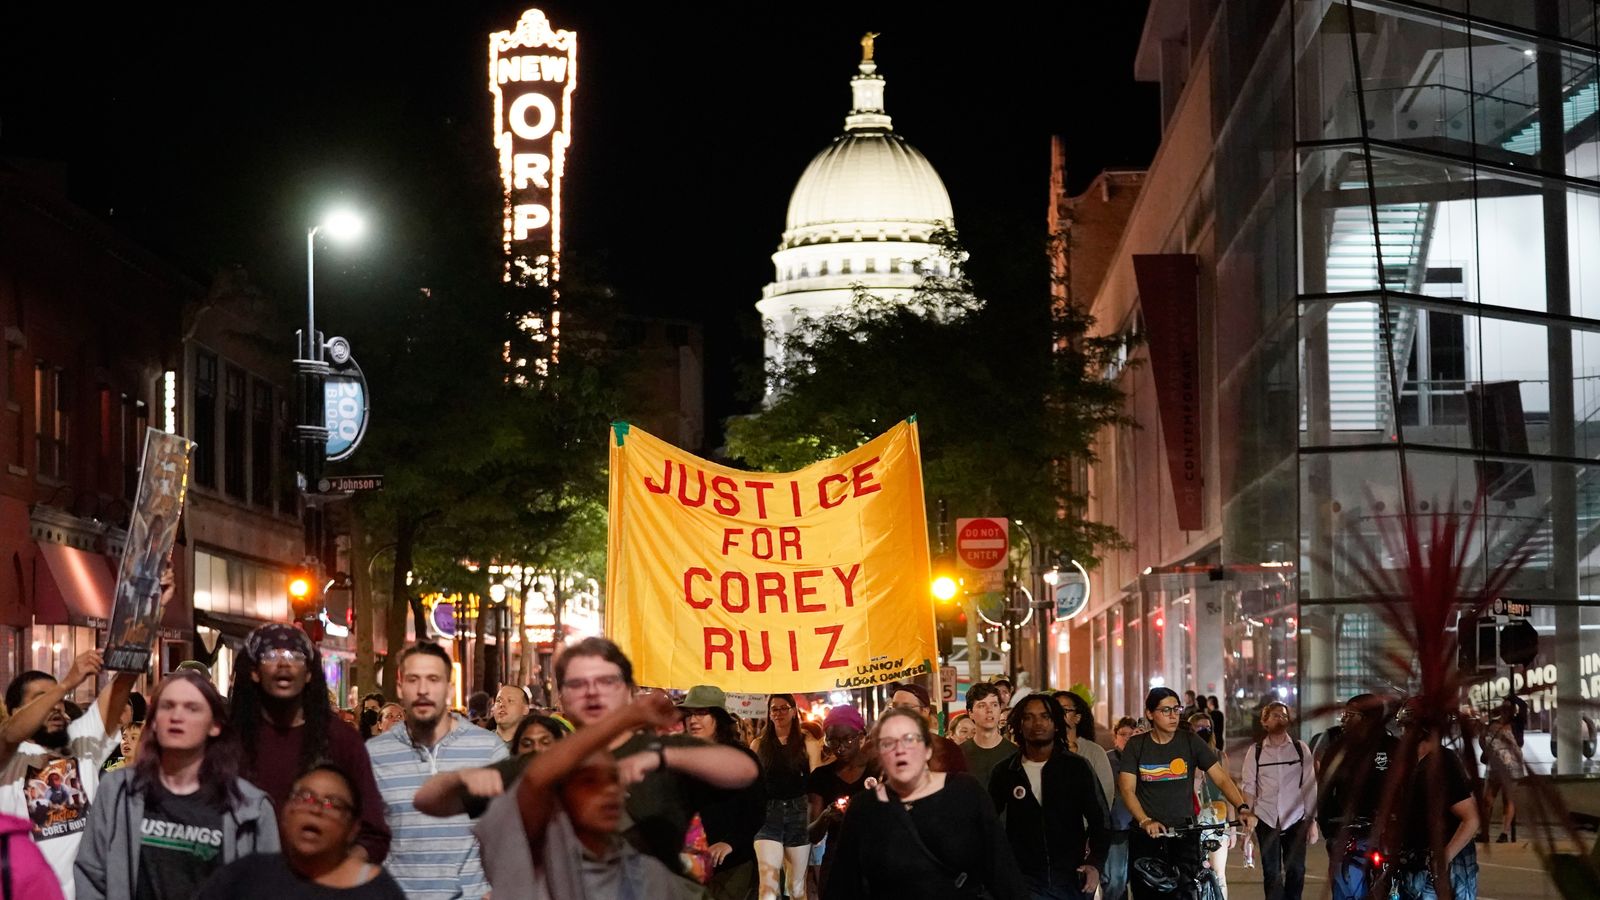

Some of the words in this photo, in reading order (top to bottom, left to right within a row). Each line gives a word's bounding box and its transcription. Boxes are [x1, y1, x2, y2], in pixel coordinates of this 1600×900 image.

[497, 55, 568, 85] NEW
[326, 388, 338, 440] BLOCK
[338, 382, 359, 442] 200
[1181, 350, 1194, 481] CONTEMPORARY
[338, 479, 374, 490] Johnson
[644, 457, 882, 520] JUSTICE
[722, 526, 802, 561] FOR
[965, 529, 979, 537] DO
[981, 528, 1000, 537] NOT
[967, 551, 999, 560] ENTER
[683, 563, 861, 614] COREY
[703, 624, 849, 672] RUIZ
[835, 674, 877, 688] LABOR
[879, 664, 927, 682] DONATED
[856, 658, 904, 675] UNION
[1469, 673, 1525, 702] GOOD
[42, 822, 69, 837] COREY
